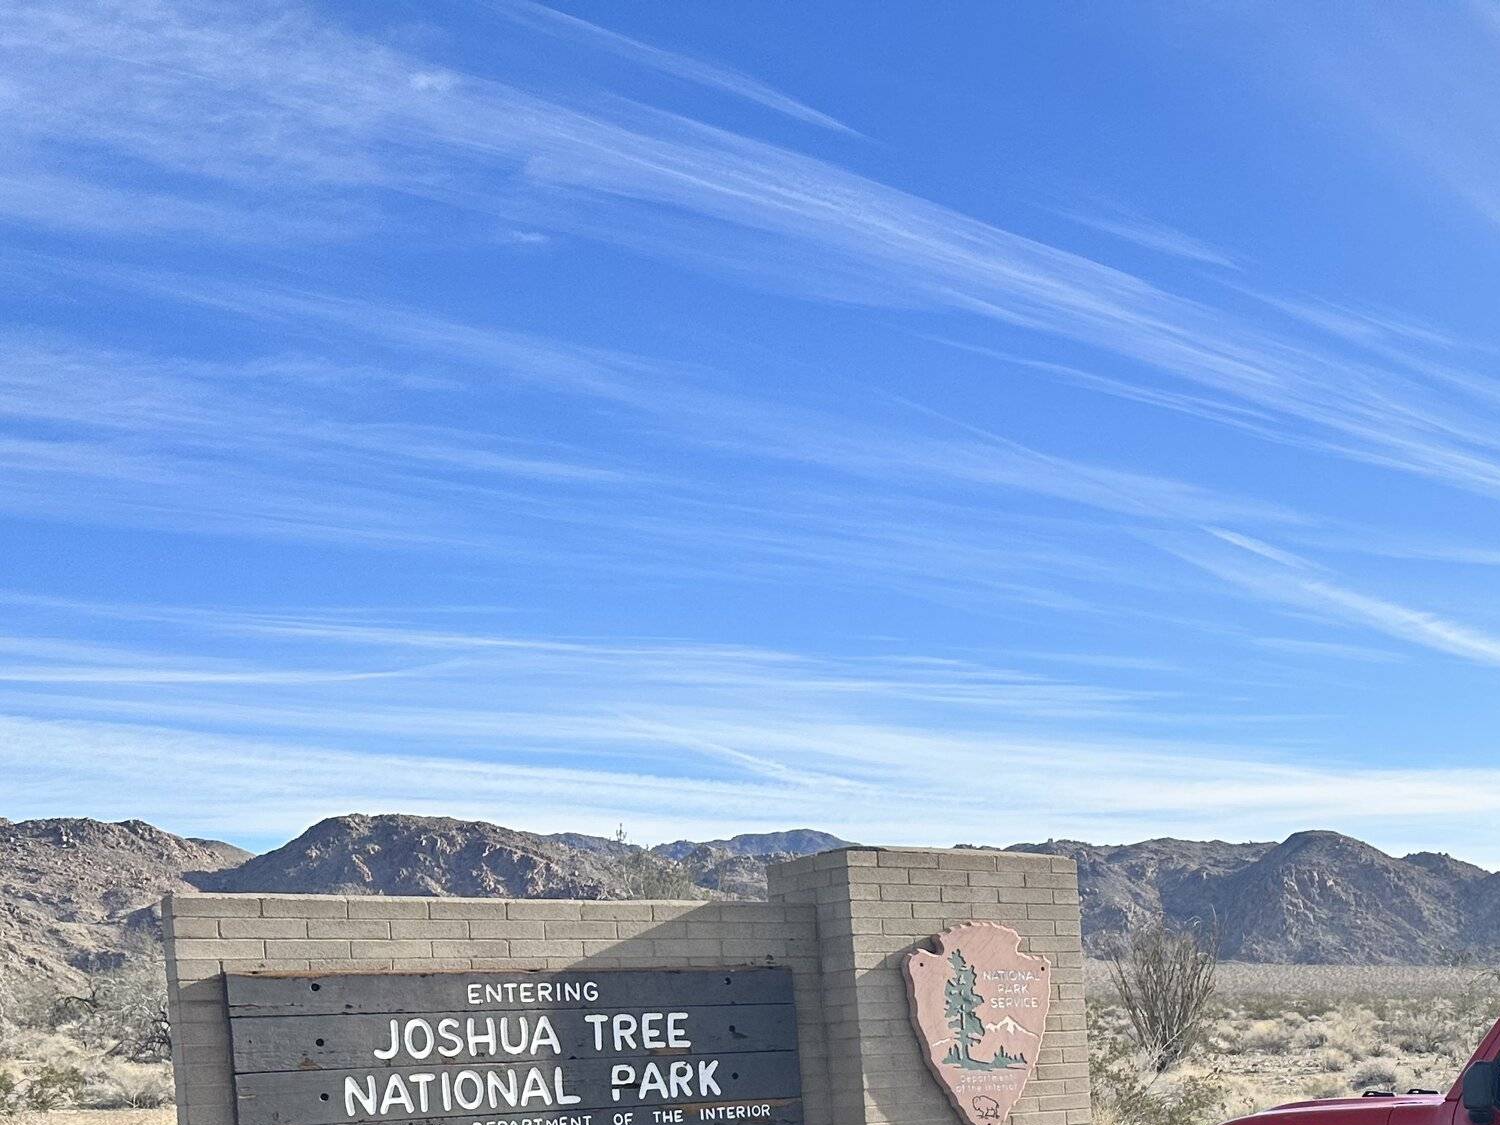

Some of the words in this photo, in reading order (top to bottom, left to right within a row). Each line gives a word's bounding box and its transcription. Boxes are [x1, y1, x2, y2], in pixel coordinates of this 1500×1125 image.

[983, 970, 1040, 981] NATIONAL
[467, 981, 600, 1004] ENTERING
[997, 983, 1030, 994] PARK
[990, 997, 1039, 1008] SERVICE
[373, 1015, 562, 1060] JOSHUA
[584, 1012, 692, 1051] TREE
[344, 1066, 582, 1117] NATIONAL
[611, 1060, 722, 1102] PARK
[613, 1112, 634, 1125] OF
[653, 1109, 684, 1124] THE
[700, 1104, 771, 1121] INTERIOR
